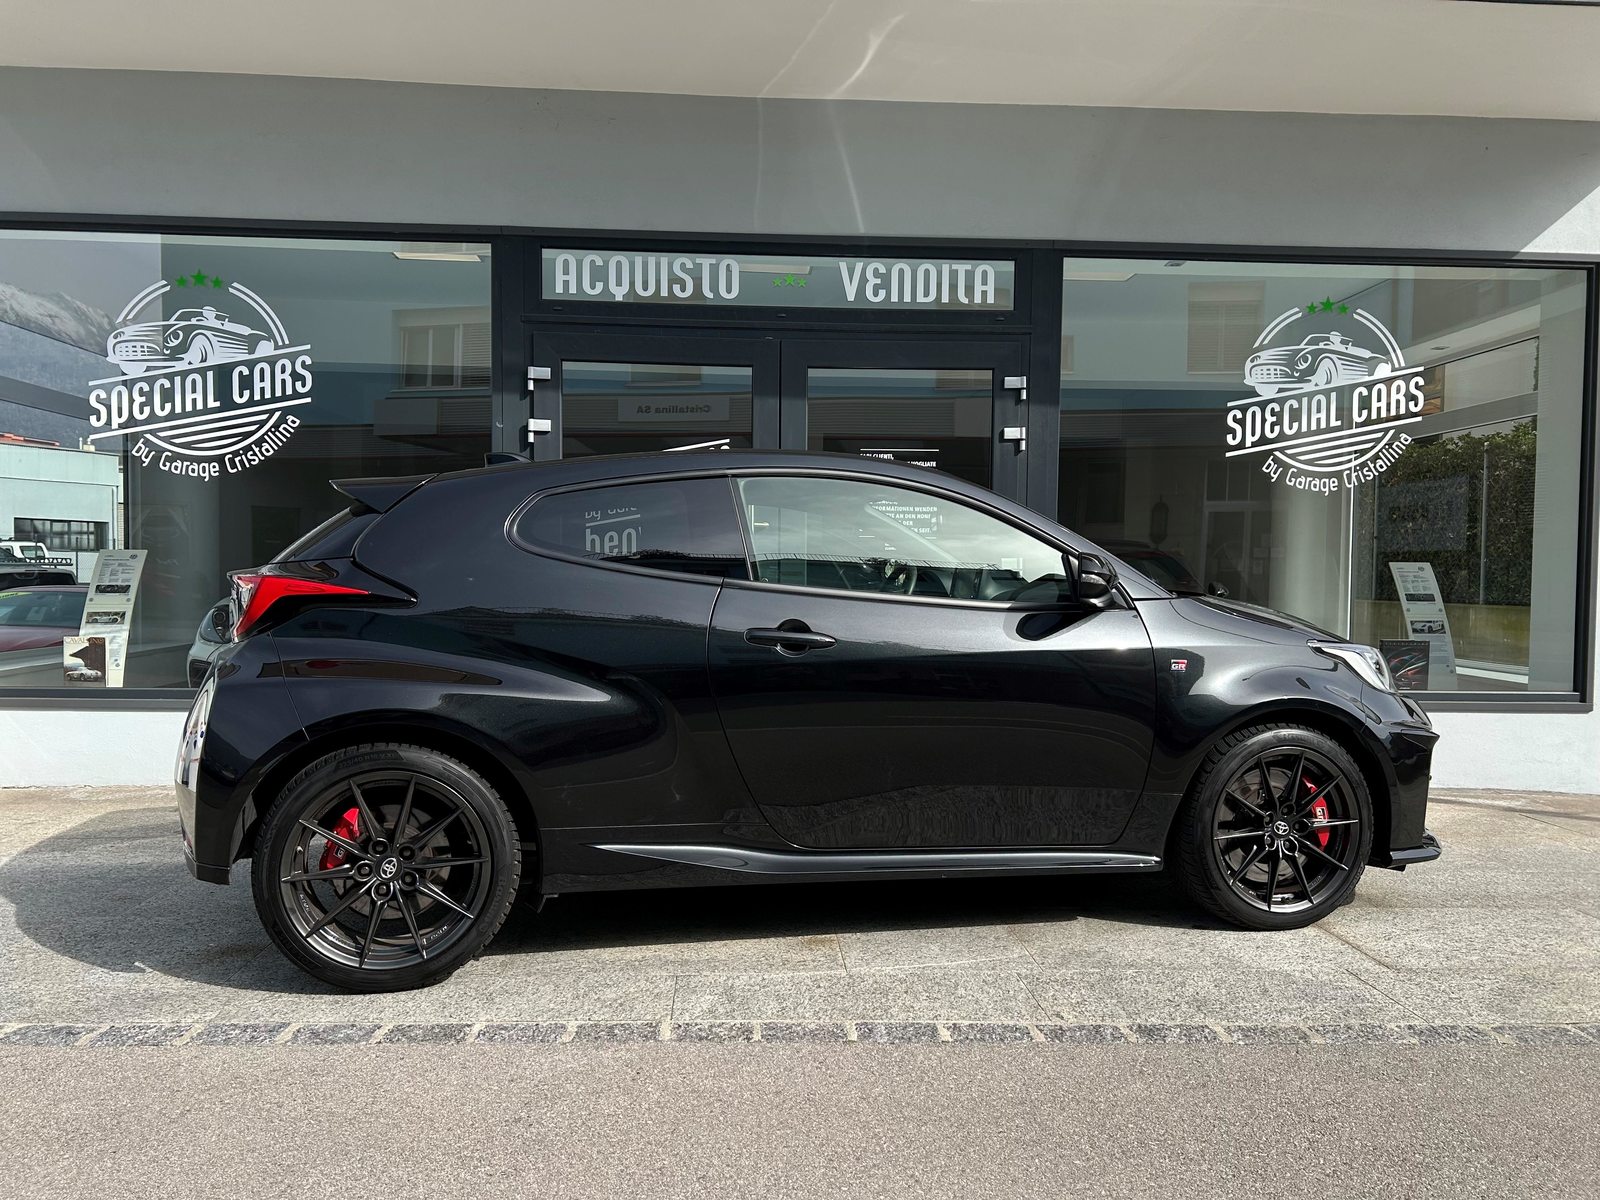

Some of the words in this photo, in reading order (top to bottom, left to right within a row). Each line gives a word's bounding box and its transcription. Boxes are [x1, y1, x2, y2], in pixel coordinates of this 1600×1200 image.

[555, 253, 740, 301] ACQUISTO
[838, 261, 995, 304] VENDITA
[89, 371, 221, 429] SPECIAL
[231, 355, 313, 404] CARS
[1226, 392, 1342, 447] SPECIAL
[1352, 376, 1425, 423] CARS
[131, 438, 155, 466] by
[159, 452, 220, 482] Garage
[224, 414, 301, 474] Cristallina
[1262, 456, 1283, 483] by
[1285, 468, 1338, 497] Garage
[1343, 432, 1413, 488] Cristallina
[1171, 662, 1186, 670] GR
